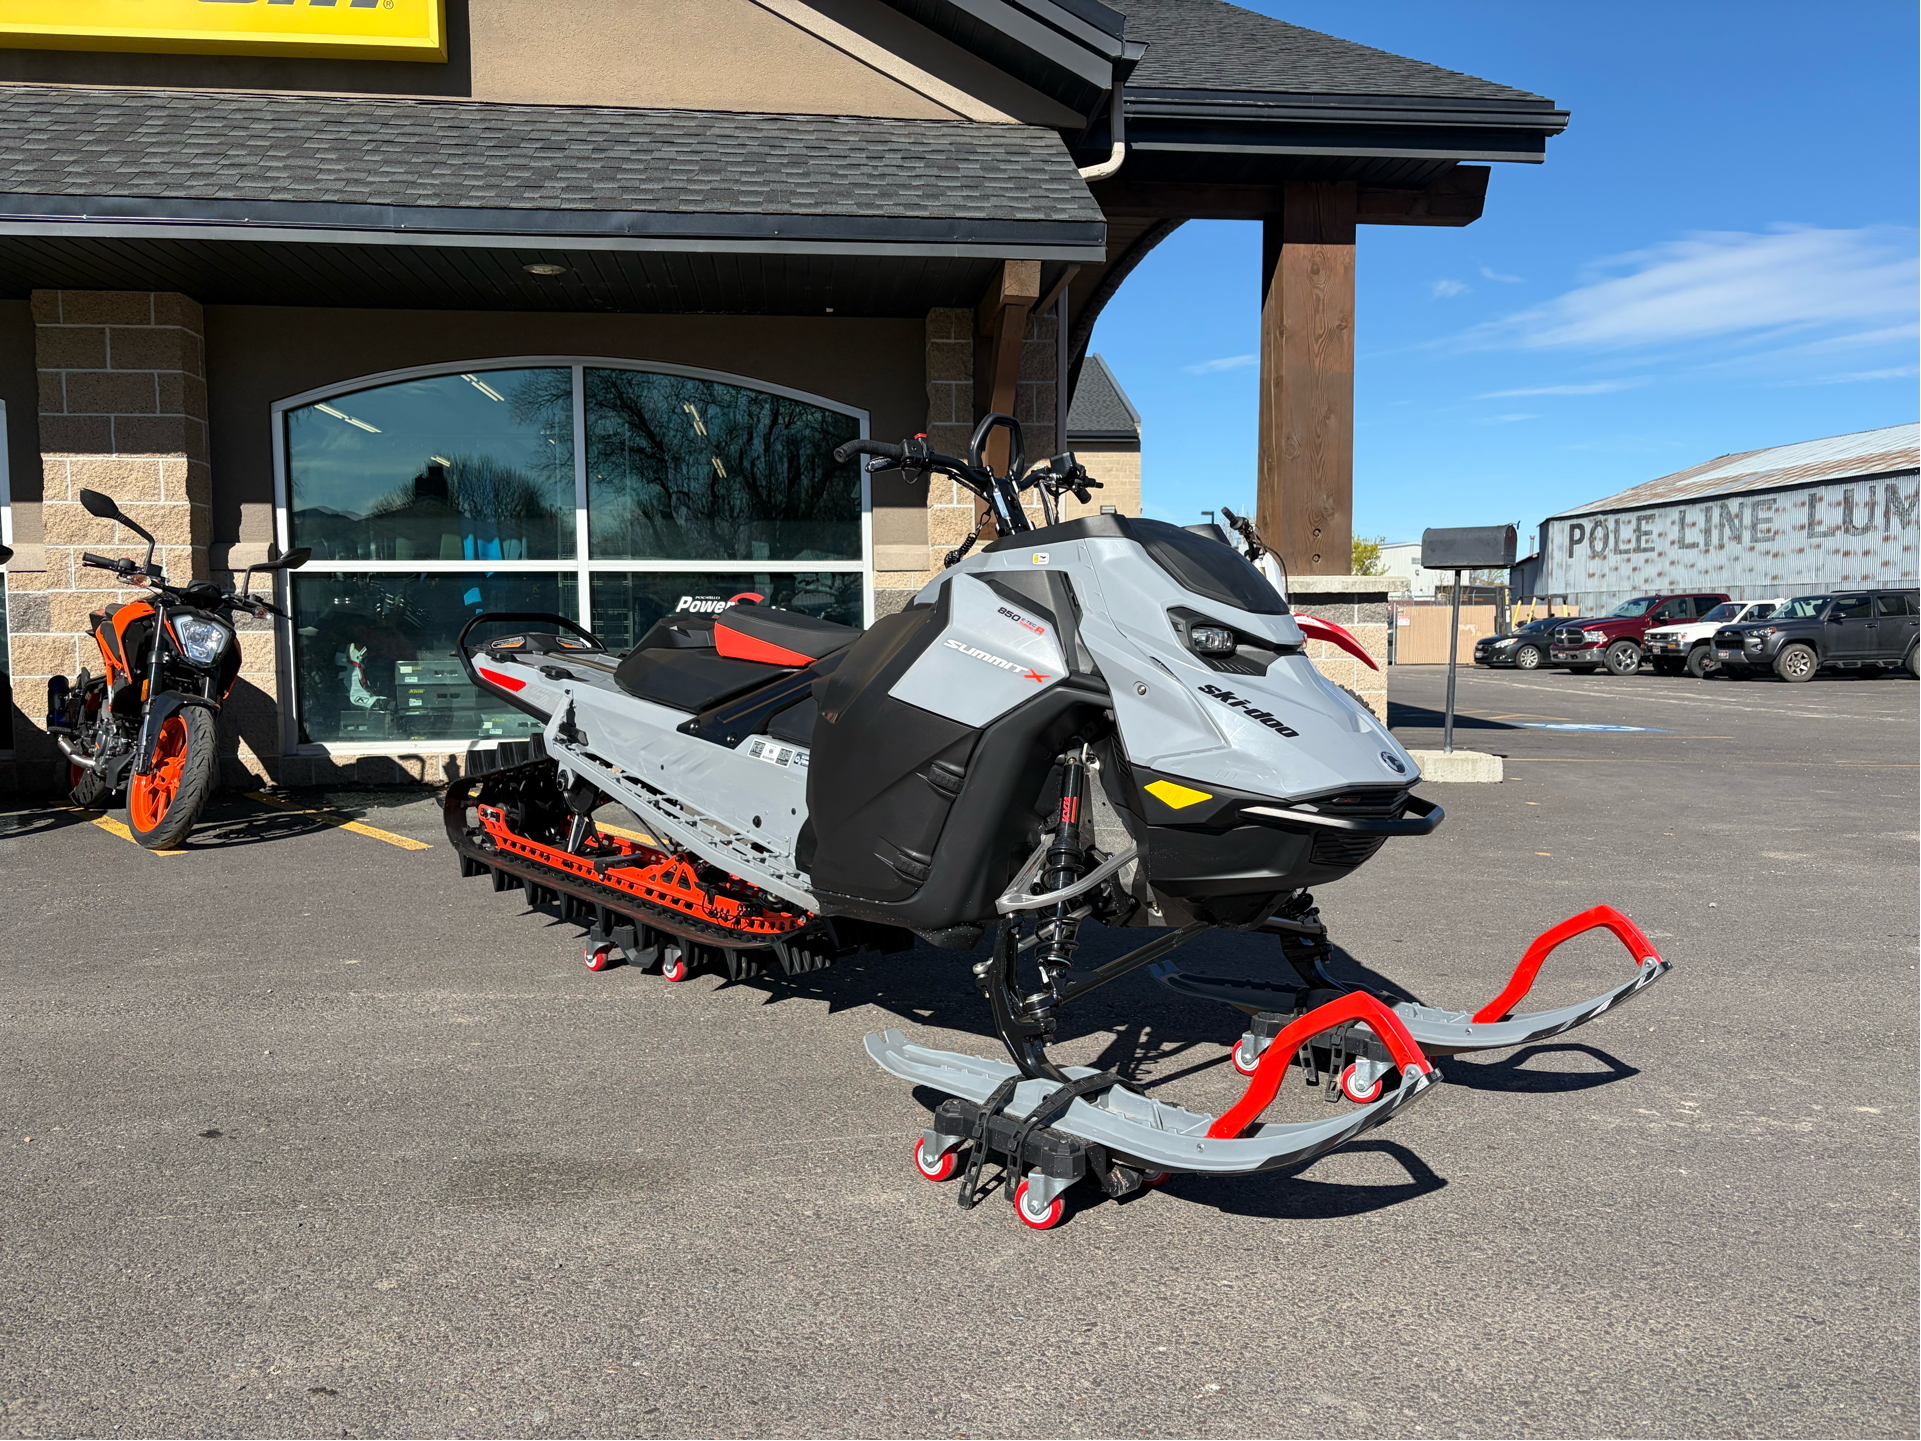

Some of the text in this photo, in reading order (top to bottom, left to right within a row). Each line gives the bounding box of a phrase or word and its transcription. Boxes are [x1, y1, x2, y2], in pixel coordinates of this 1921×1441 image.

[1568, 513, 1656, 560] POLE
[1677, 497, 1777, 551] LINE
[997, 606, 1022, 622] 850
[1033, 625, 1046, 636] R
[943, 638, 1029, 674] SUMMIT
[1197, 684, 1300, 738] ski-doo
